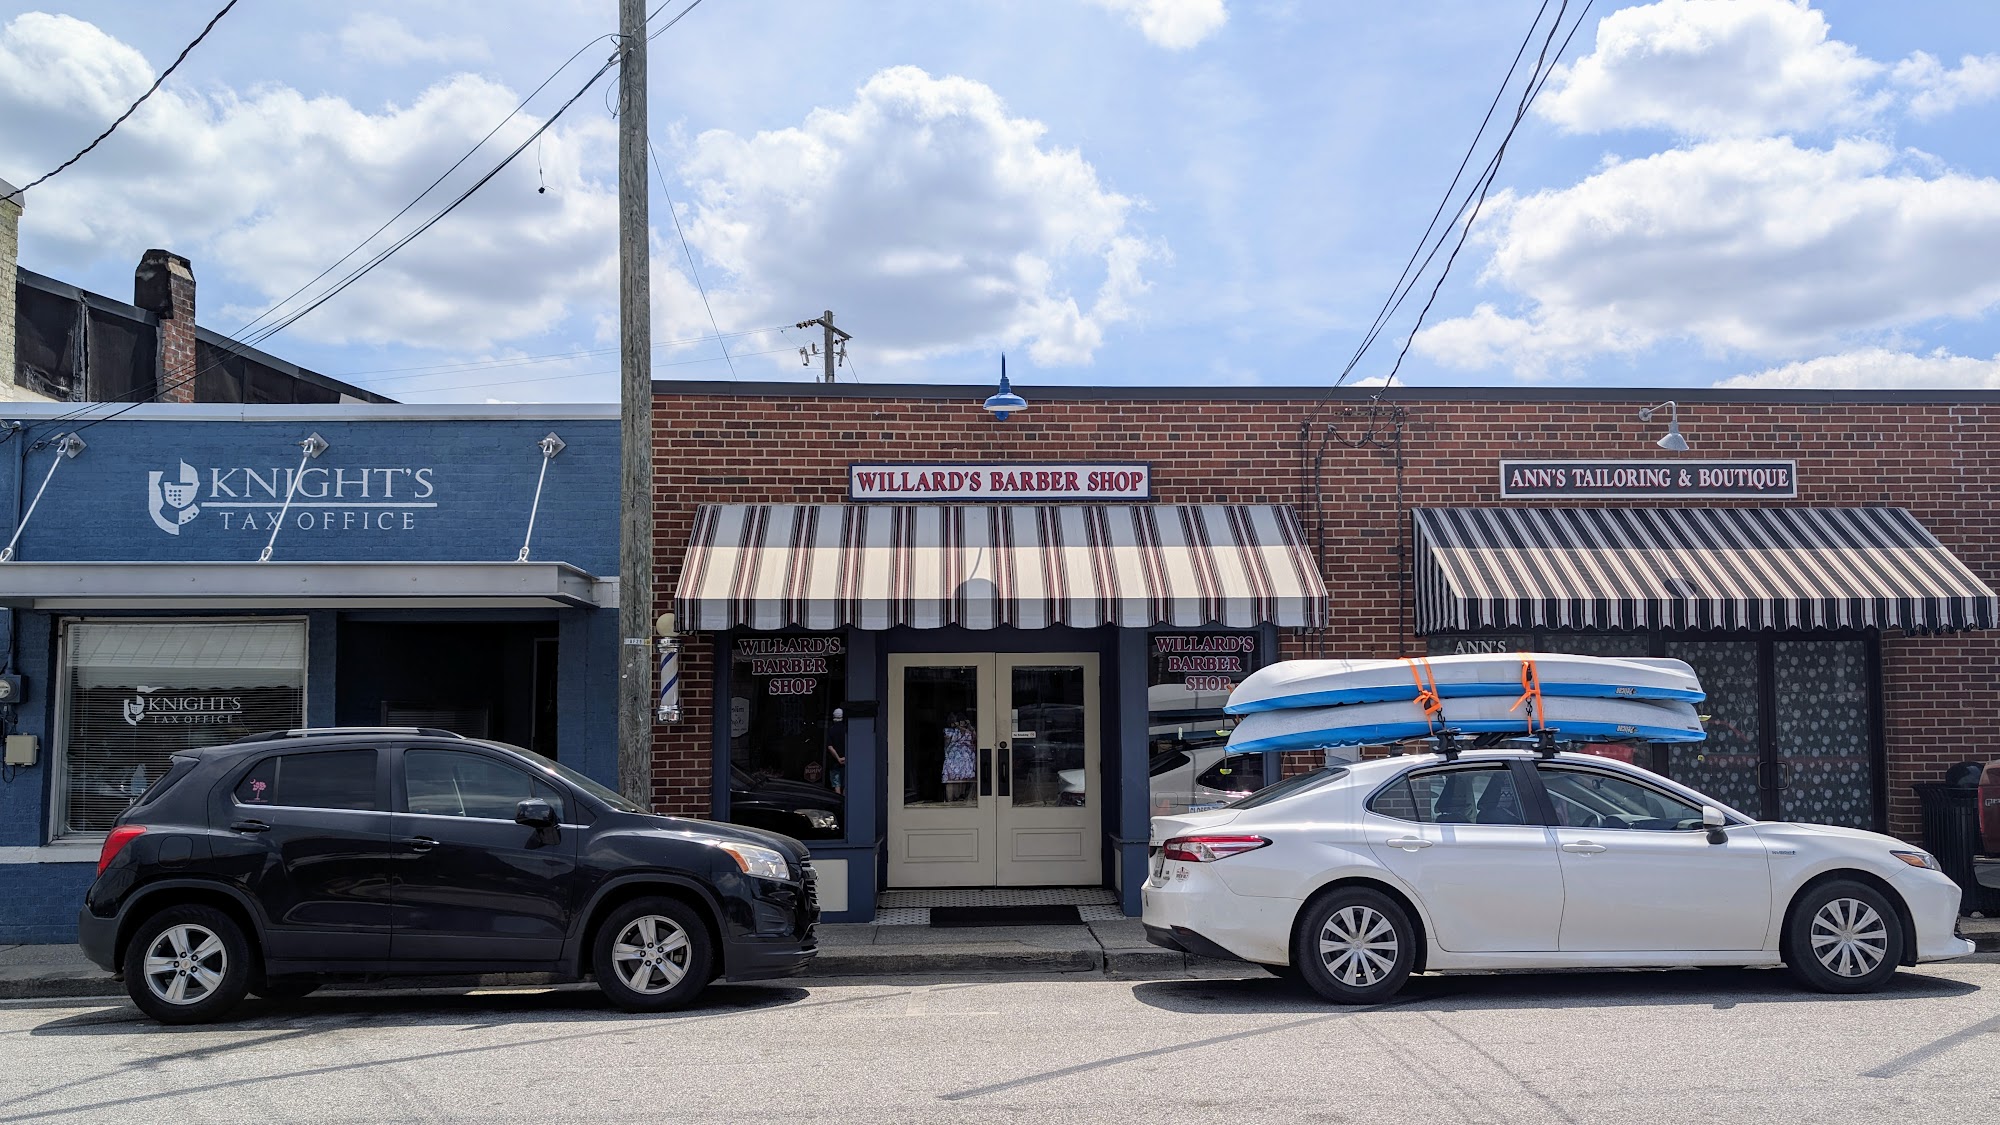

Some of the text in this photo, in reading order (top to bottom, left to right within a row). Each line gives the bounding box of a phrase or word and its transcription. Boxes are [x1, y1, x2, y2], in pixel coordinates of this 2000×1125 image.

[209, 467, 434, 499] KNIGHT'S
[856, 471, 1143, 493] WILLARD'S BARBER SHOP
[1510, 468, 1790, 491] ANN'S TAILORING & BOUTIQUE
[219, 511, 415, 530] TAX OFFICE
[738, 637, 841, 656] WILLARD'S
[1155, 636, 1255, 653] WILLARD'S
[1454, 640, 1507, 655] ANN'S
[752, 658, 828, 675] BARBER
[1168, 656, 1242, 673] BARBER
[769, 677, 817, 695] SHOP
[1185, 675, 1232, 692] SHOP
[148, 696, 241, 711] KNIGHT'S
[152, 715, 233, 724] TAX OFFICE
